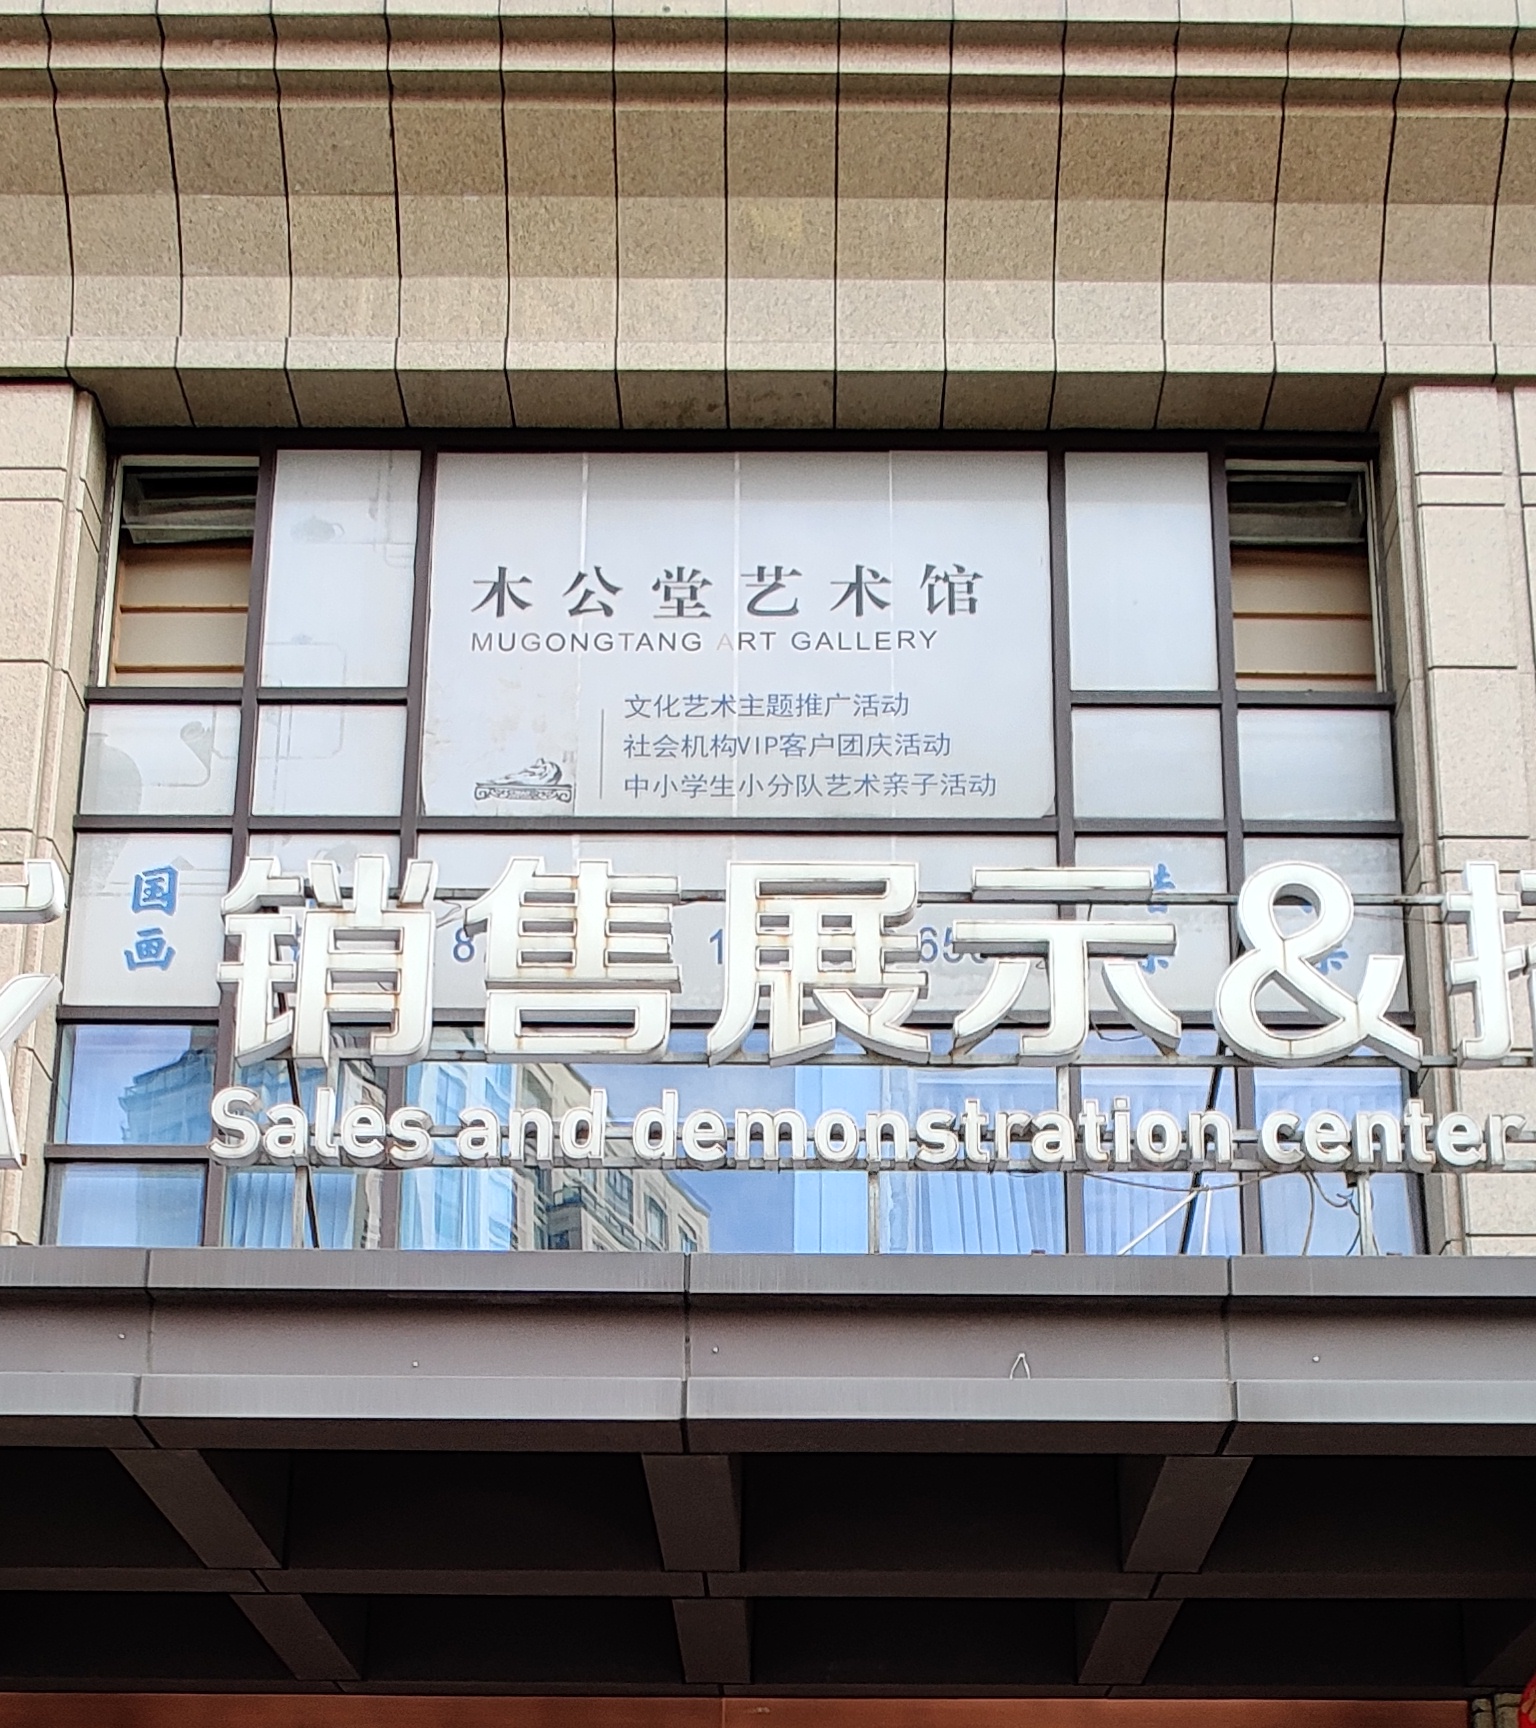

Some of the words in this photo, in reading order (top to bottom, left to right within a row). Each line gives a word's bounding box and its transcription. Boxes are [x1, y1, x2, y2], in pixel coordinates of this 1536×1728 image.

[470, 564, 984, 619] 木公堂艺术馆
[470, 630, 703, 654] MUGONGTANG
[715, 630, 777, 654] ART
[790, 629, 939, 653] GALLERY
[623, 693, 911, 719] 文化艺术主题推广活动
[622, 732, 952, 759] 社会机构VIP客户团庆活动
[623, 773, 998, 799] 中小学生小分队艺术亲子活动
[124, 864, 181, 972] 国画
[208, 1085, 434, 1166] Sales
[457, 1086, 610, 1164] and
[632, 1088, 1237, 1167] demonstration
[1258, 1097, 1528, 1169] center
